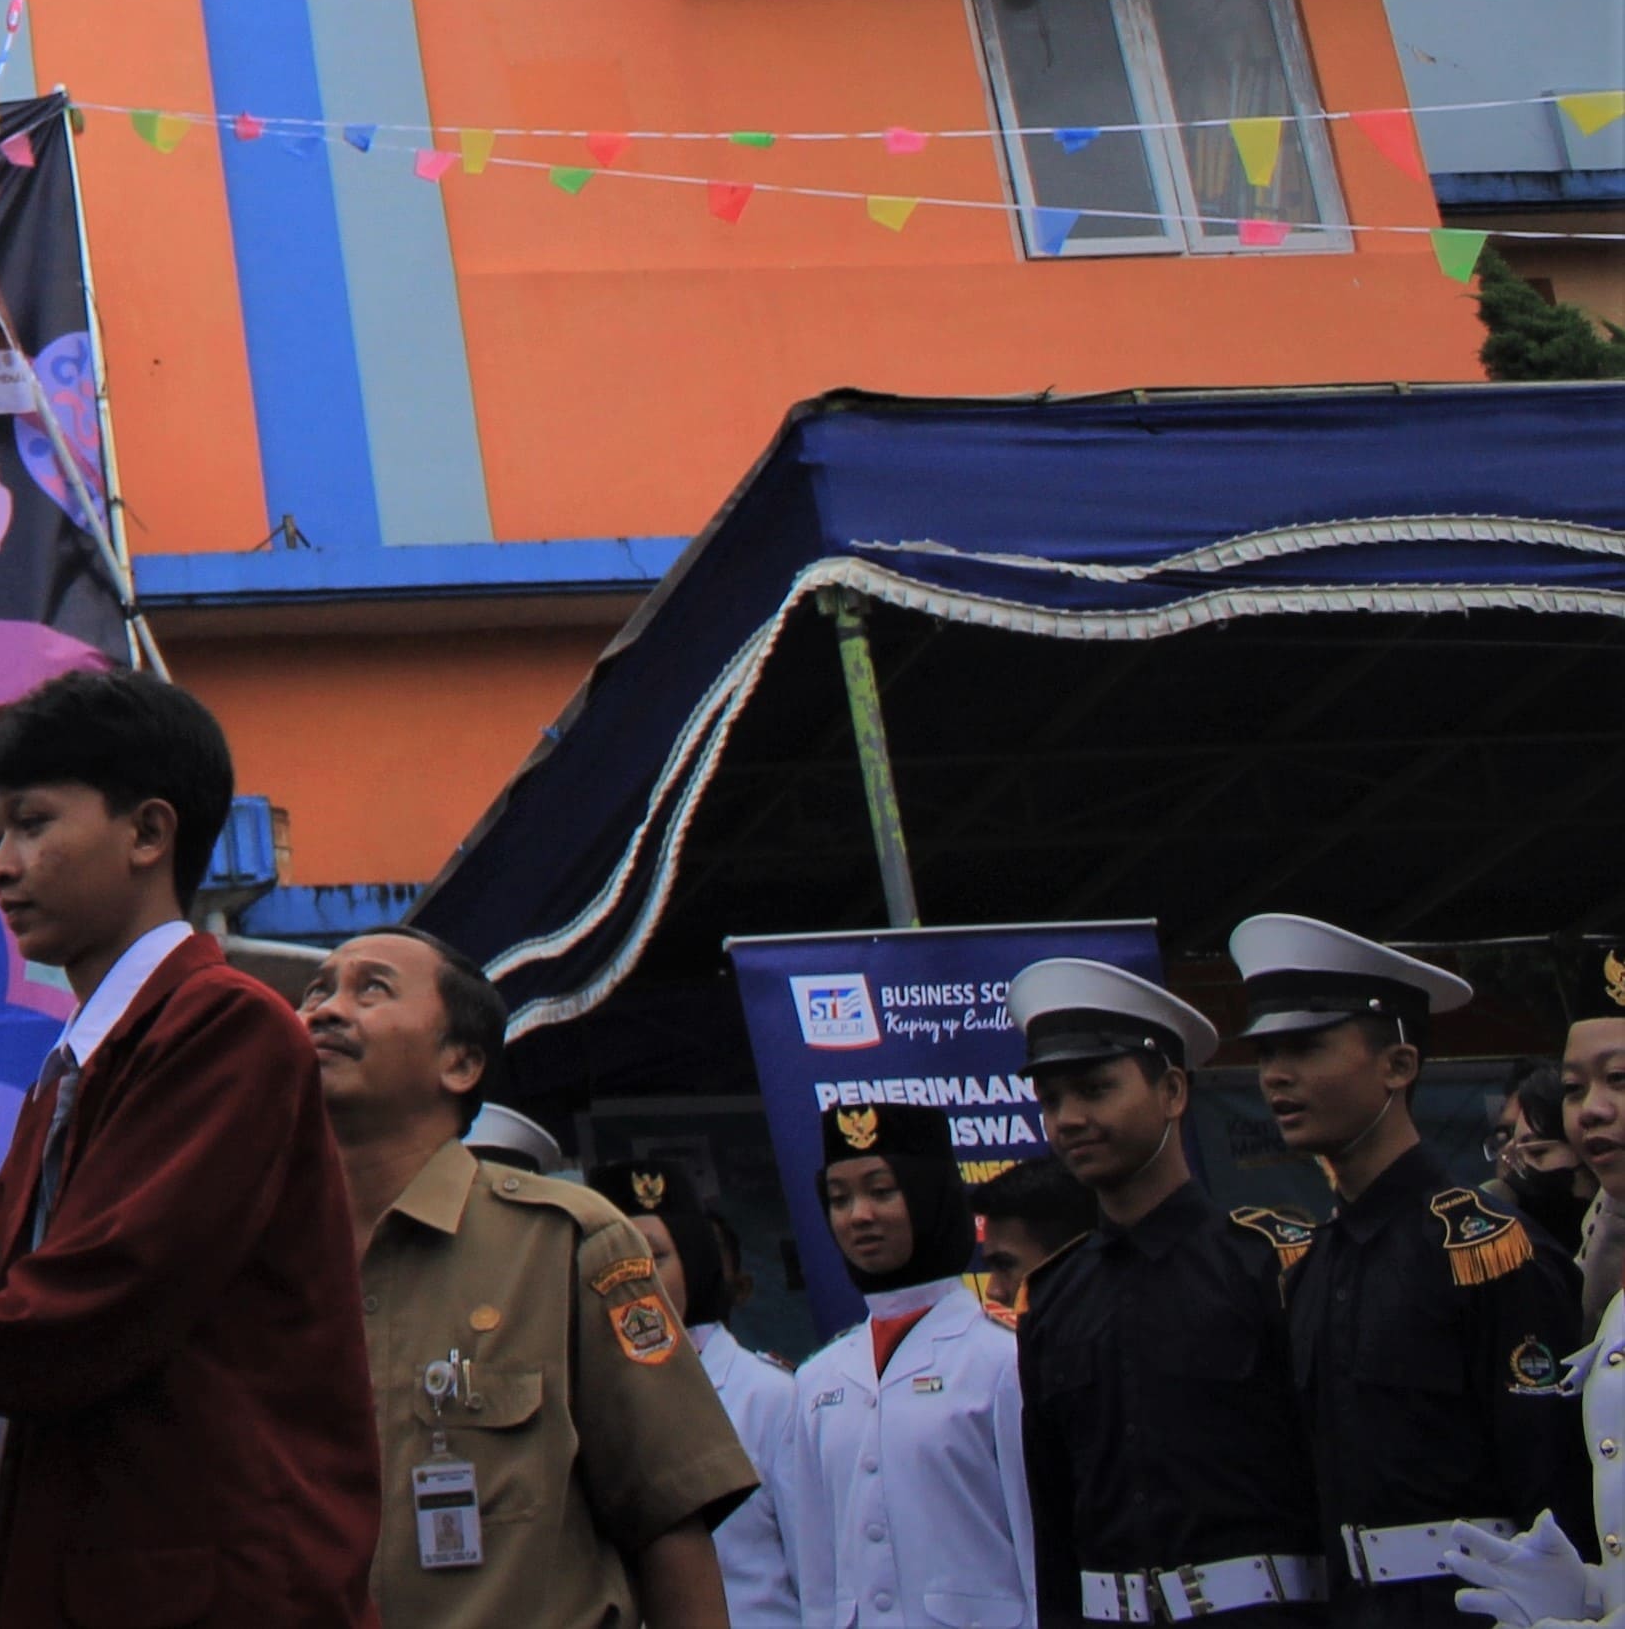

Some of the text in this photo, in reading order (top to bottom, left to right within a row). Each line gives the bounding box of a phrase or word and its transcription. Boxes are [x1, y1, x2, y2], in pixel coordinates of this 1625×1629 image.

[881, 983, 974, 1008] BUSINESS
[884, 1010, 940, 1044] Keeping
[942, 1019, 960, 1040] up
[814, 1074, 1038, 1113] PENERIMAAN
